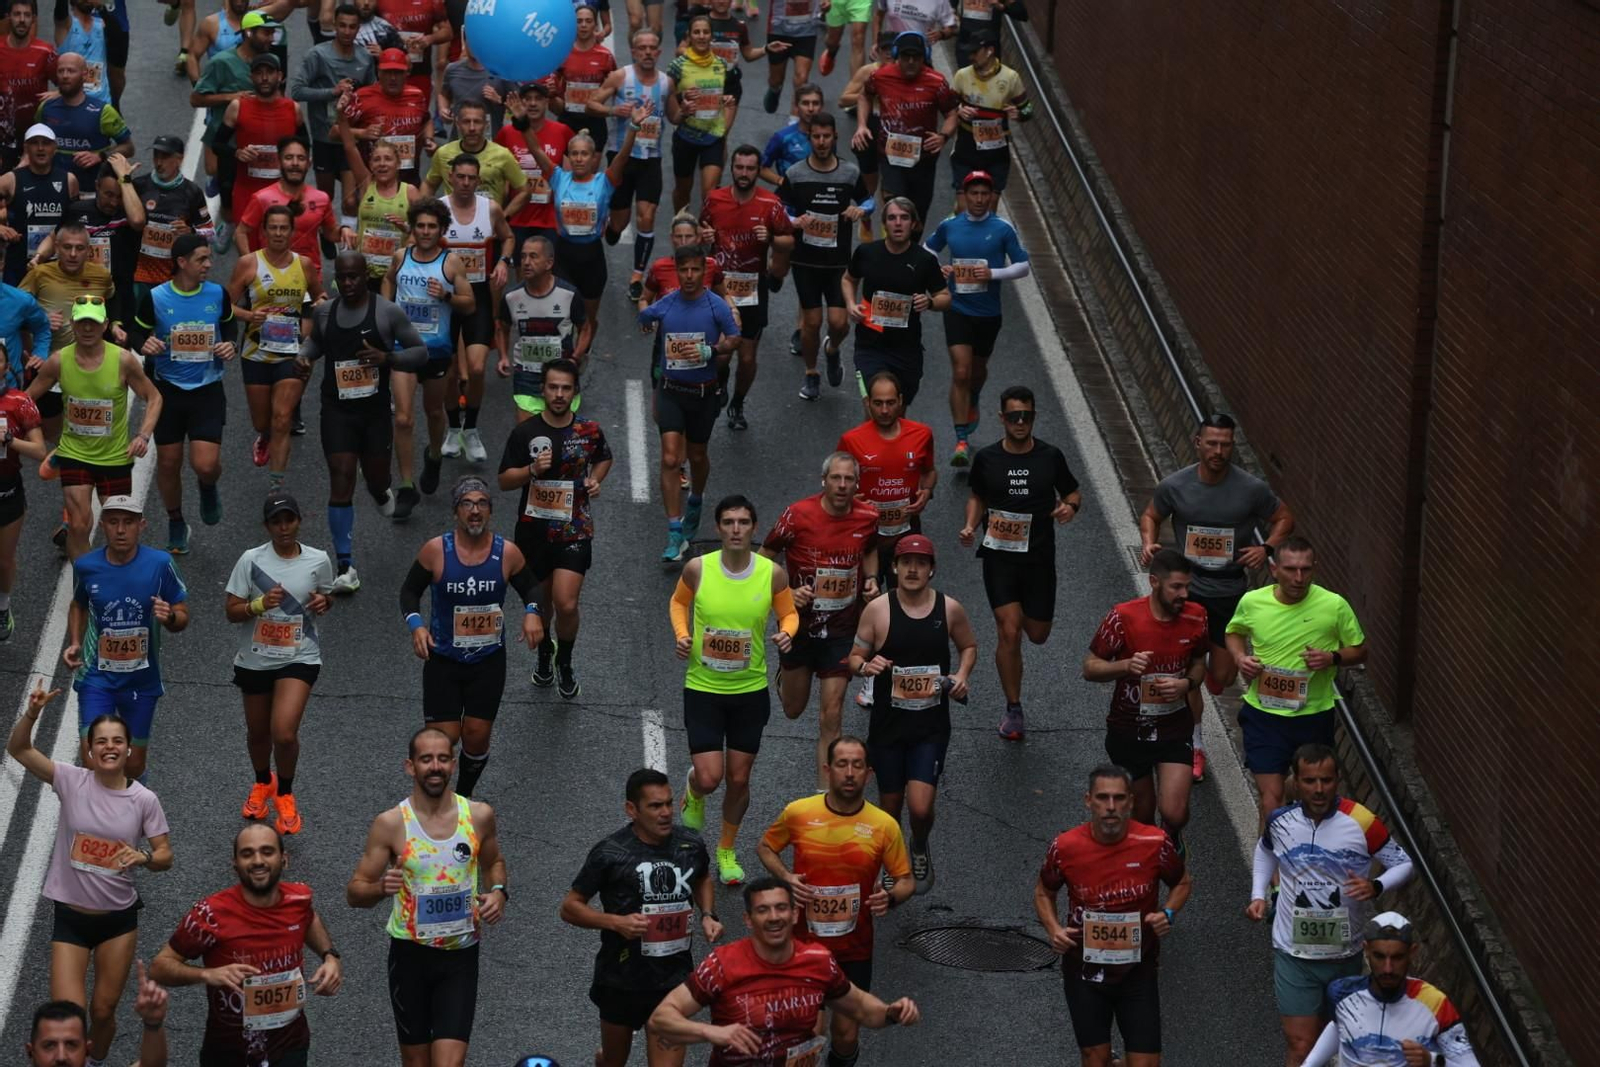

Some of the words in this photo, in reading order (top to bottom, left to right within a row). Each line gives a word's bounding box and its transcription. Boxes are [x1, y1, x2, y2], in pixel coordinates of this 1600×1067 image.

[521, 11, 558, 48] 1:45
[148, 230, 173, 244] 5049
[726, 280, 750, 292] 4755
[877, 299, 902, 313] 5904
[177, 333, 206, 346] 6338
[527, 345, 552, 358] 7416
[342, 367, 369, 382] 6281
[74, 406, 102, 420] 3872
[1007, 469, 1030, 477] ALCO
[878, 478, 904, 487] base
[535, 488, 563, 503] 3997
[993, 520, 1020, 535] 4542
[1193, 537, 1223, 550] 4555
[478, 579, 497, 592] FIT
[461, 615, 492, 629] 4121
[105, 639, 138, 653] 3743
[709, 638, 740, 653] 4068
[899, 677, 930, 691] 4267
[1264, 675, 1295, 692] 4369
[425, 896, 462, 915] 3069
[813, 898, 848, 914] 5324
[655, 915, 681, 933] 434
[1299, 921, 1337, 937] 9317
[1091, 925, 1129, 942] 5544
[253, 985, 293, 1007] 5057
